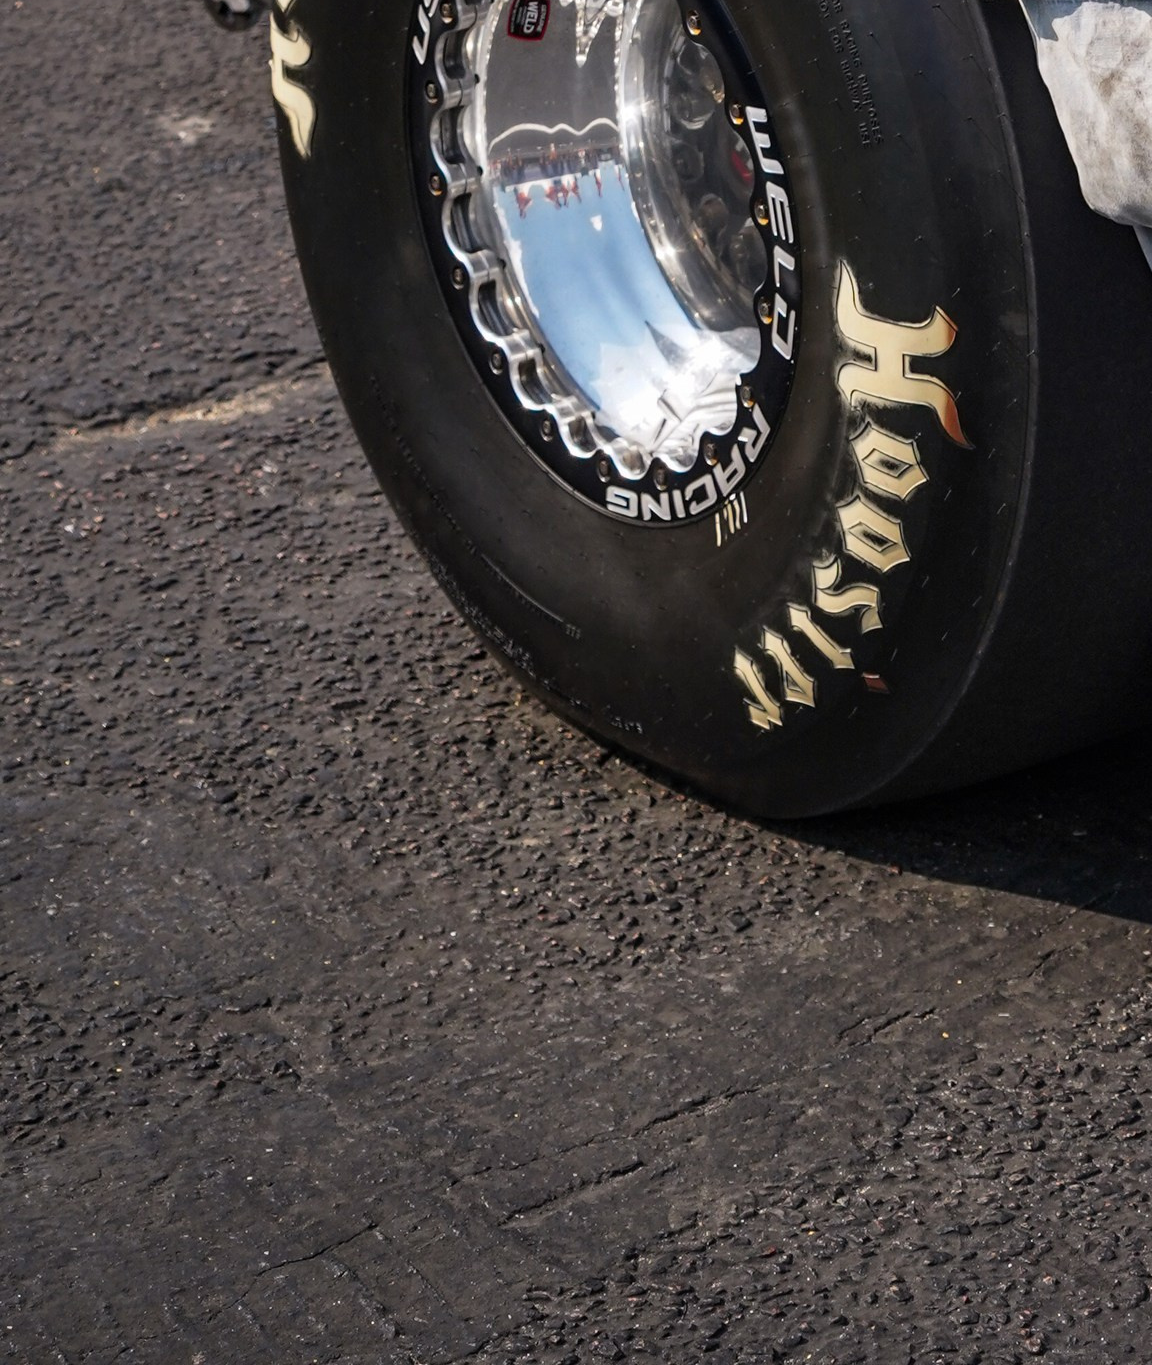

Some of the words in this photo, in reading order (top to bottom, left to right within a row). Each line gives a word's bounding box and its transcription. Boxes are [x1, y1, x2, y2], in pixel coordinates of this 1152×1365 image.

[523, 1, 539, 34] WELD
[746, 106, 797, 362] WELD
[605, 402, 772, 521] RACING
